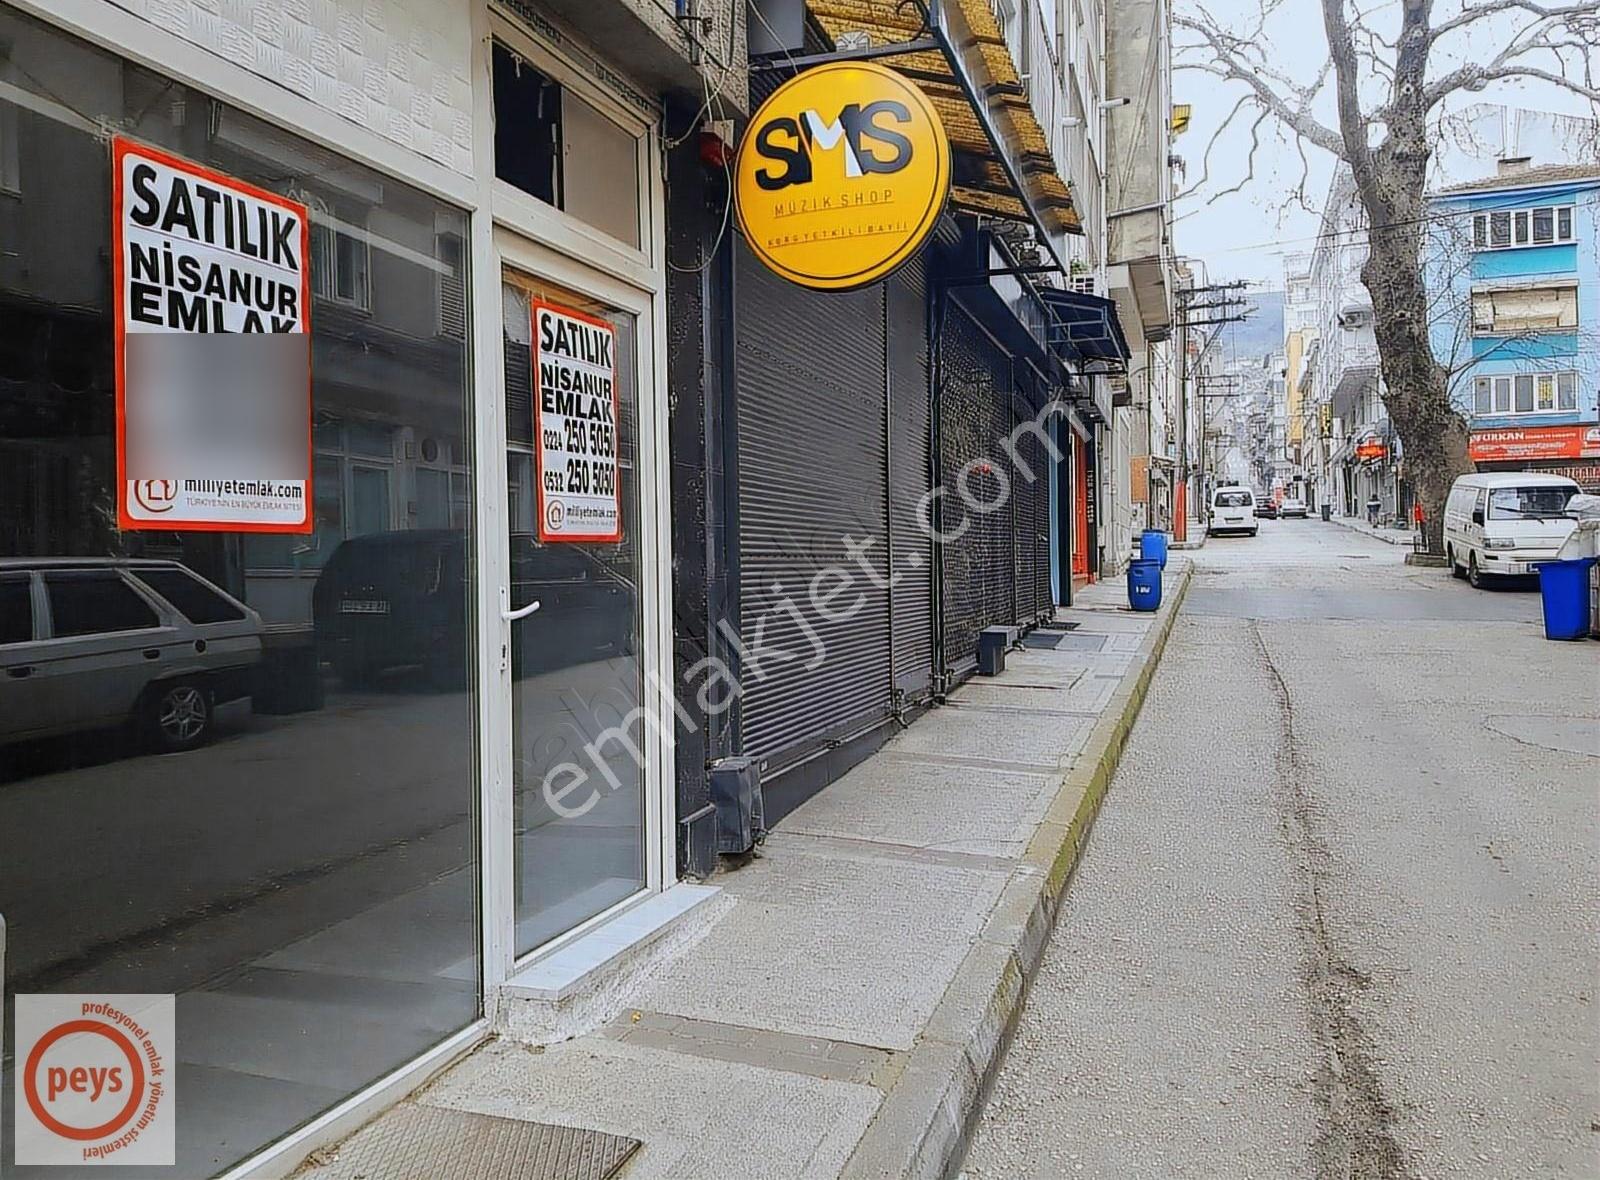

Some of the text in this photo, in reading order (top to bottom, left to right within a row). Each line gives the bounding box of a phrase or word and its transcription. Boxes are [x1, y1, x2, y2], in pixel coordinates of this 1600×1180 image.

[755, 100, 913, 190] SMS
[130, 164, 298, 270] SATILIK
[840, 189, 893, 208] SHOP
[130, 241, 298, 319] NİSANUR
[541, 313, 612, 369] SATILIK
[541, 360, 612, 401] NİSANUR
[541, 387, 613, 424] EMLAK
[564, 418, 587, 455] 250
[590, 422, 614, 459] 5050
[185, 480, 302, 498] milliyetemlak.com
[567, 458, 589, 494] 250
[592, 461, 615, 496] 5050
